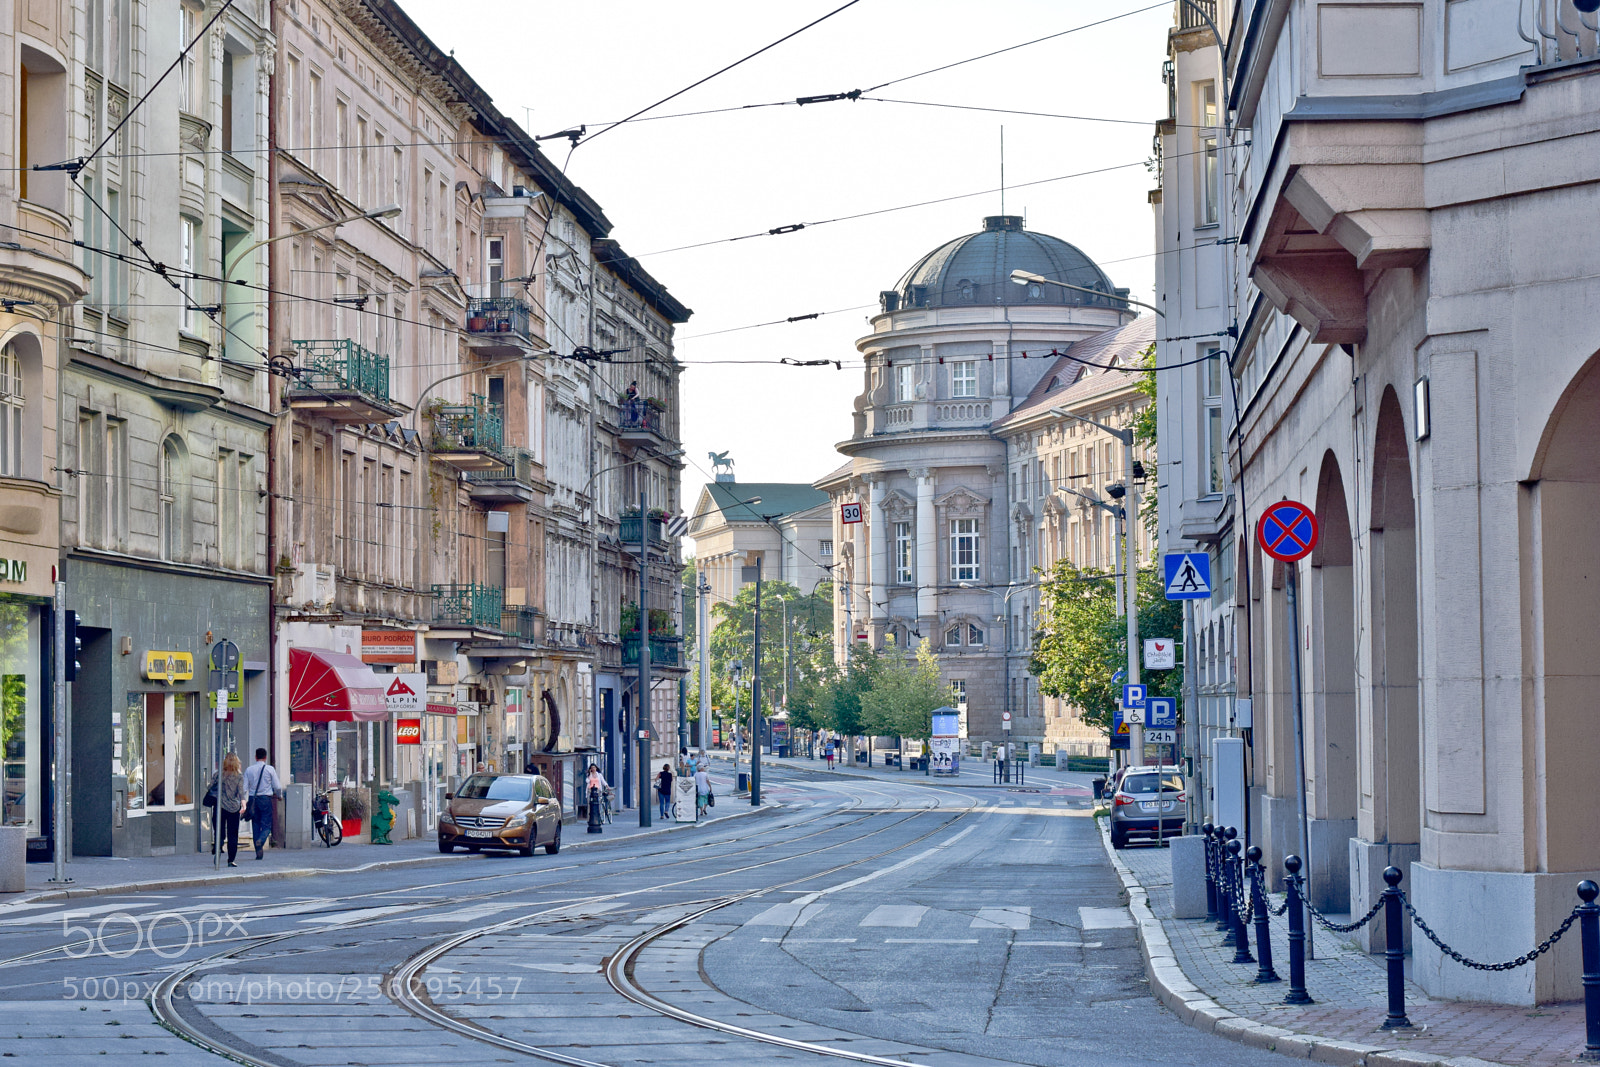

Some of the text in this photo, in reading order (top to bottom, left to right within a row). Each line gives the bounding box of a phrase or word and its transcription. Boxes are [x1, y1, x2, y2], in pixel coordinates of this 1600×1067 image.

[845, 508, 859, 518] 30
[1128, 686, 1142, 705] P
[1151, 700, 1169, 725] P
[397, 727, 419, 736] LEGO
[1150, 732, 1171, 741] 24 h
